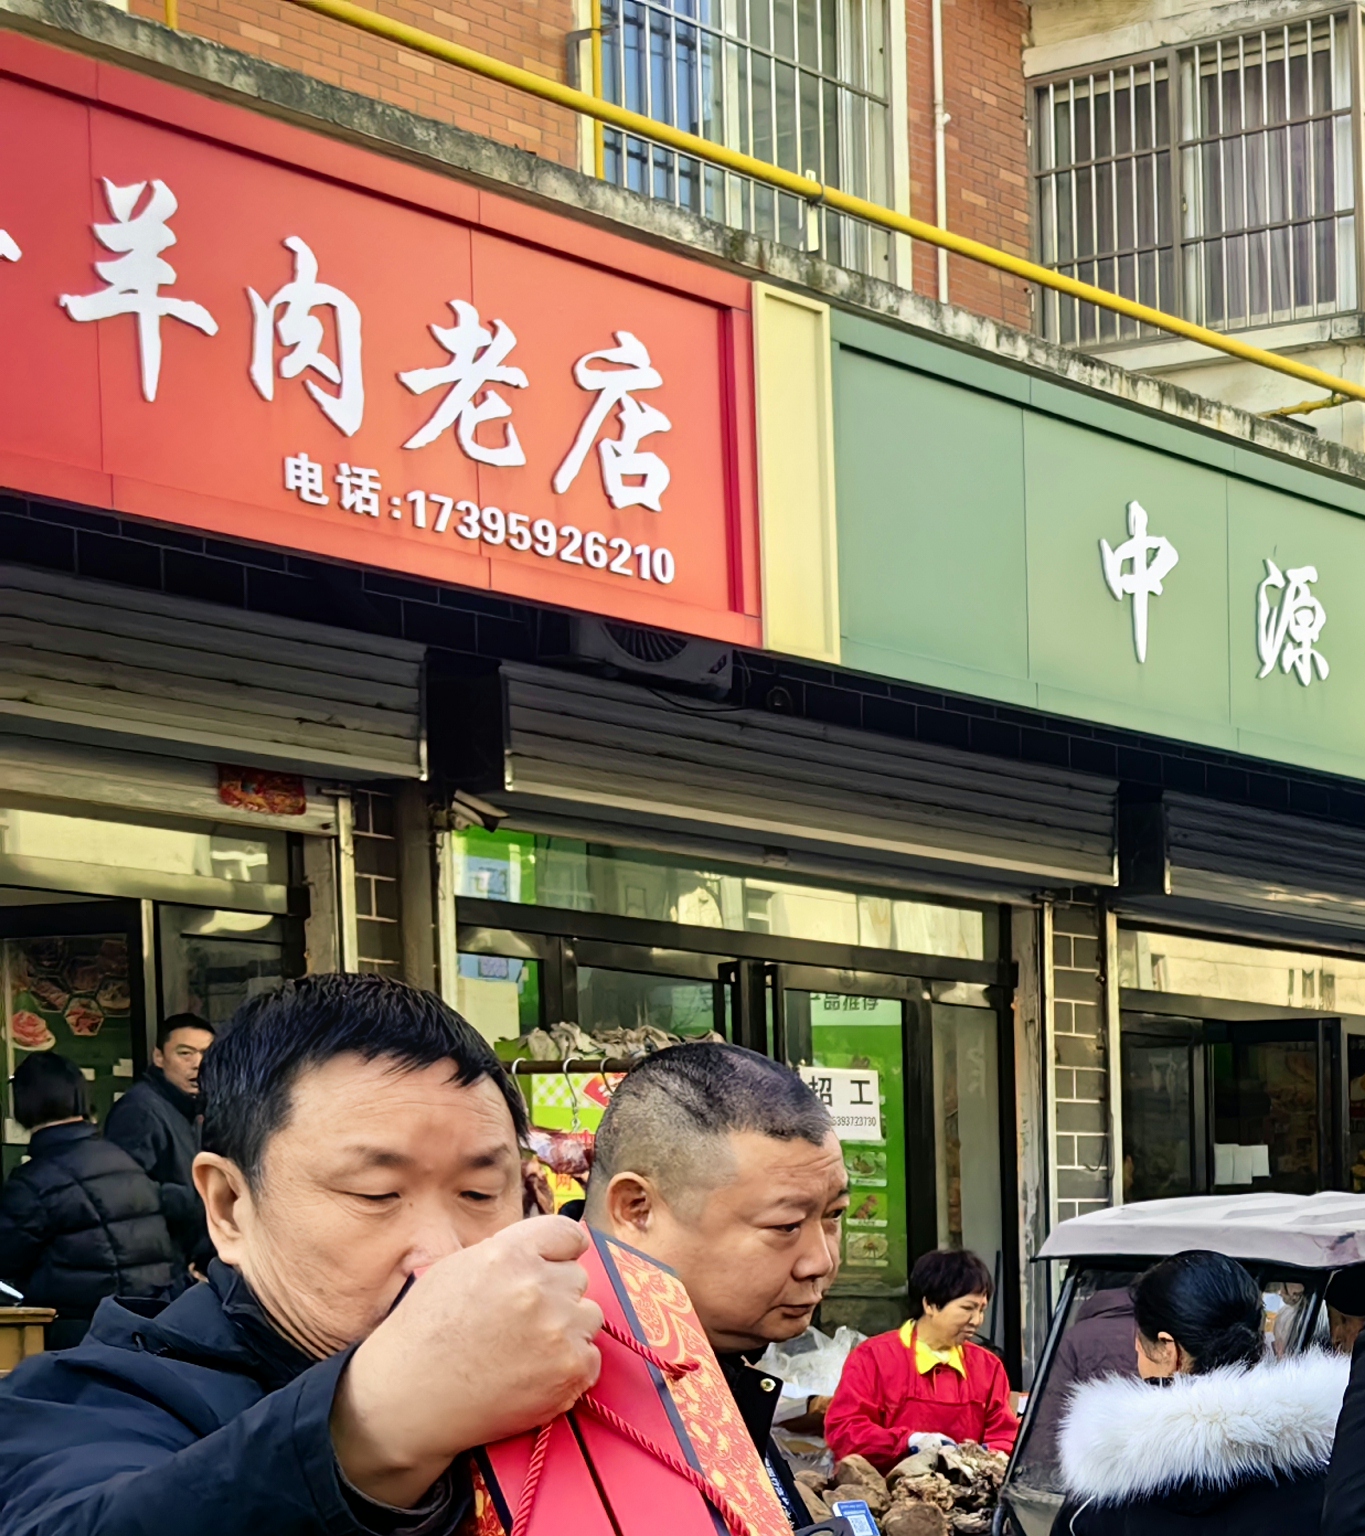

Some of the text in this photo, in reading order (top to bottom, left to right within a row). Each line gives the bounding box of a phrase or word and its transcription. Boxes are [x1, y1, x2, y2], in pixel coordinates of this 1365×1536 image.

[0, 177, 673, 513] 羊肉老店
[811, 993, 879, 1012] 品推荐
[808, 1076, 874, 1107] 招工
